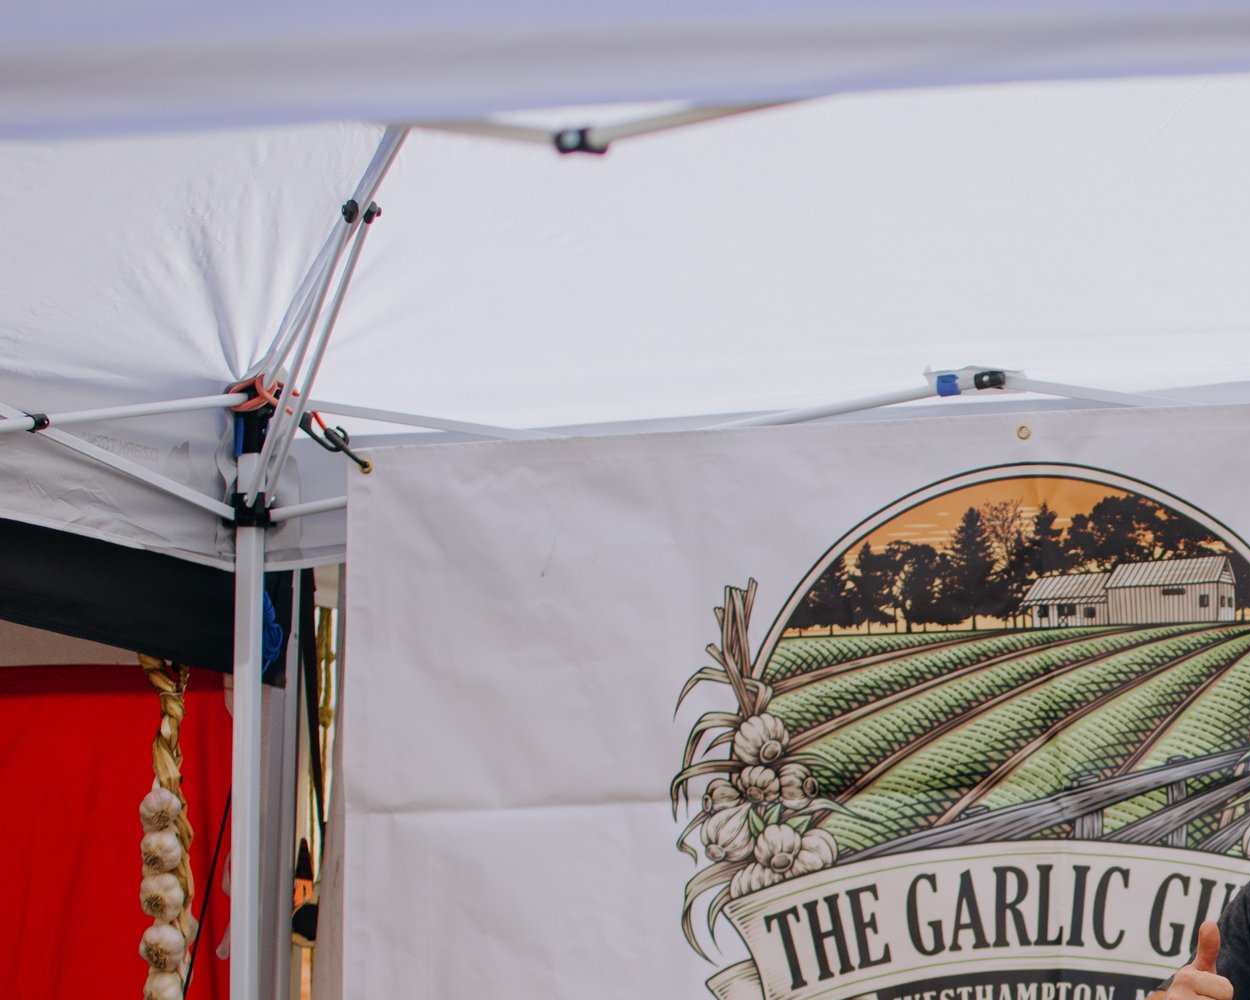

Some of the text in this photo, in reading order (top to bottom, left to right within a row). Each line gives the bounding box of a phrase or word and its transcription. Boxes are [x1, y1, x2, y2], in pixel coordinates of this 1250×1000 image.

[764, 864, 1236, 991] THE GARLIC GU
